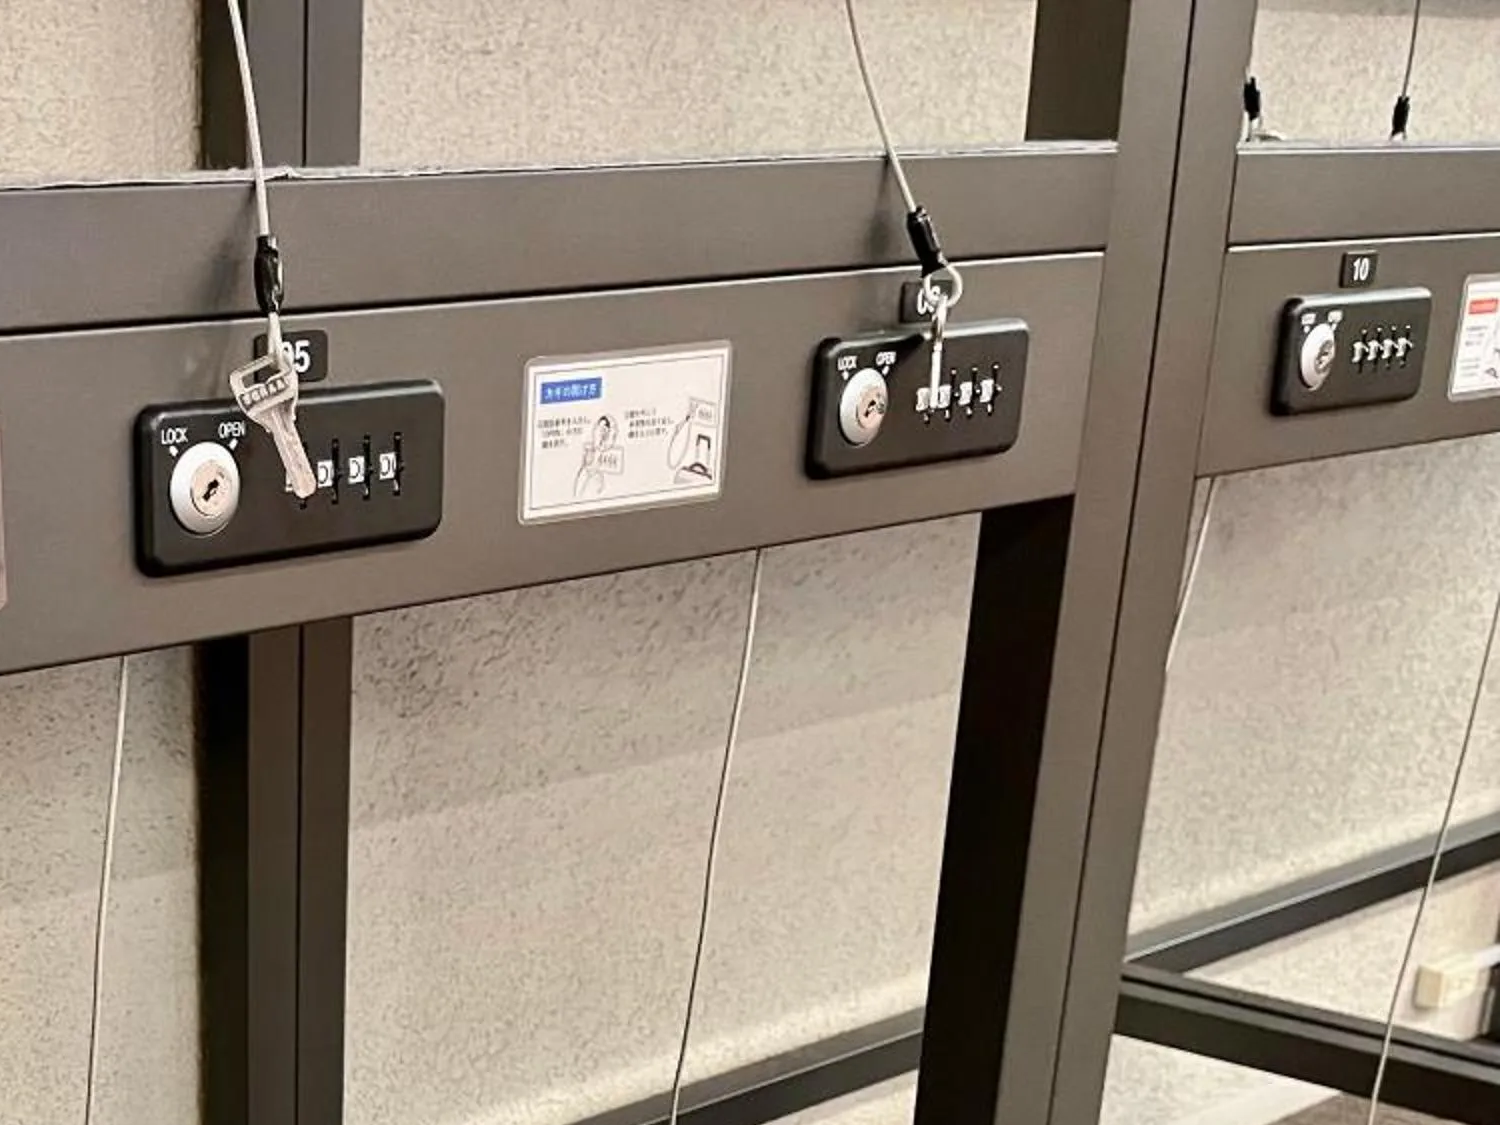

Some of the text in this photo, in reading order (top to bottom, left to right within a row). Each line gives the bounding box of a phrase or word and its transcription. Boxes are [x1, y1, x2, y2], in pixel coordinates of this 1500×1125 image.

[1353, 257, 1370, 281] 10
[161, 427, 189, 445] LOCK
[218, 420, 246, 439] OPEN
